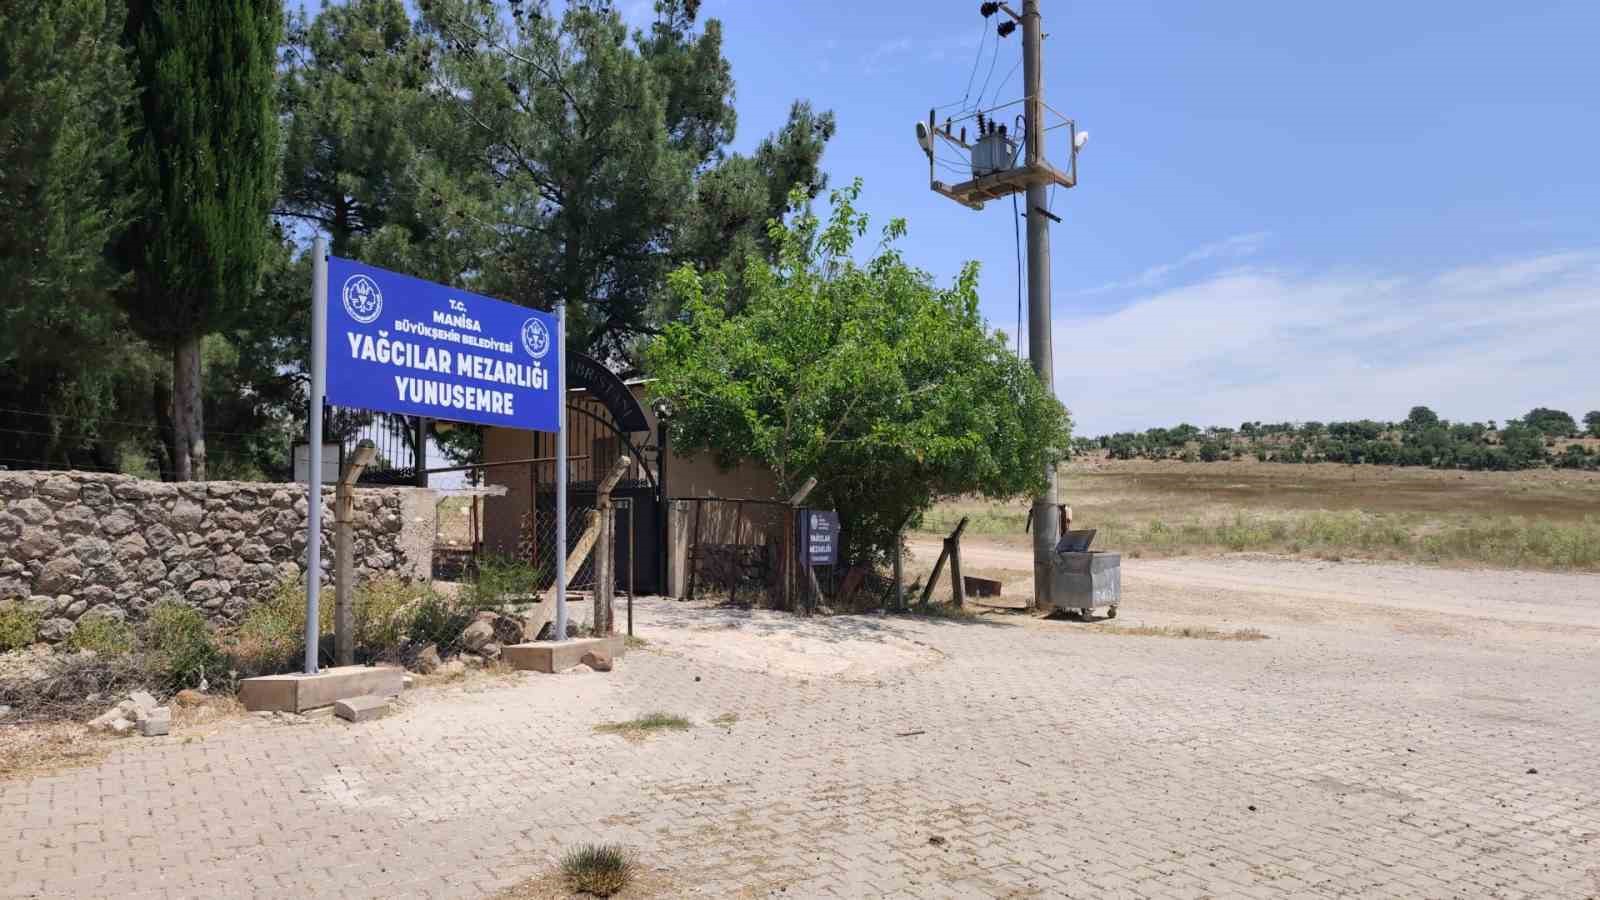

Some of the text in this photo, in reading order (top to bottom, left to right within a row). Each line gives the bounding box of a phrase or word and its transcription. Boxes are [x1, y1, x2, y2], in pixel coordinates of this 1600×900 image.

[433, 310, 482, 332] MANİSA
[449, 299, 467, 312] T.C.
[394, 319, 461, 343] BÜYÜKŞEHİR
[461, 333, 513, 354] BELEDİYESİ
[347, 330, 549, 390] YAĞCILAR MEZARLIĞI
[394, 375, 515, 416] YUNUSEMRE
